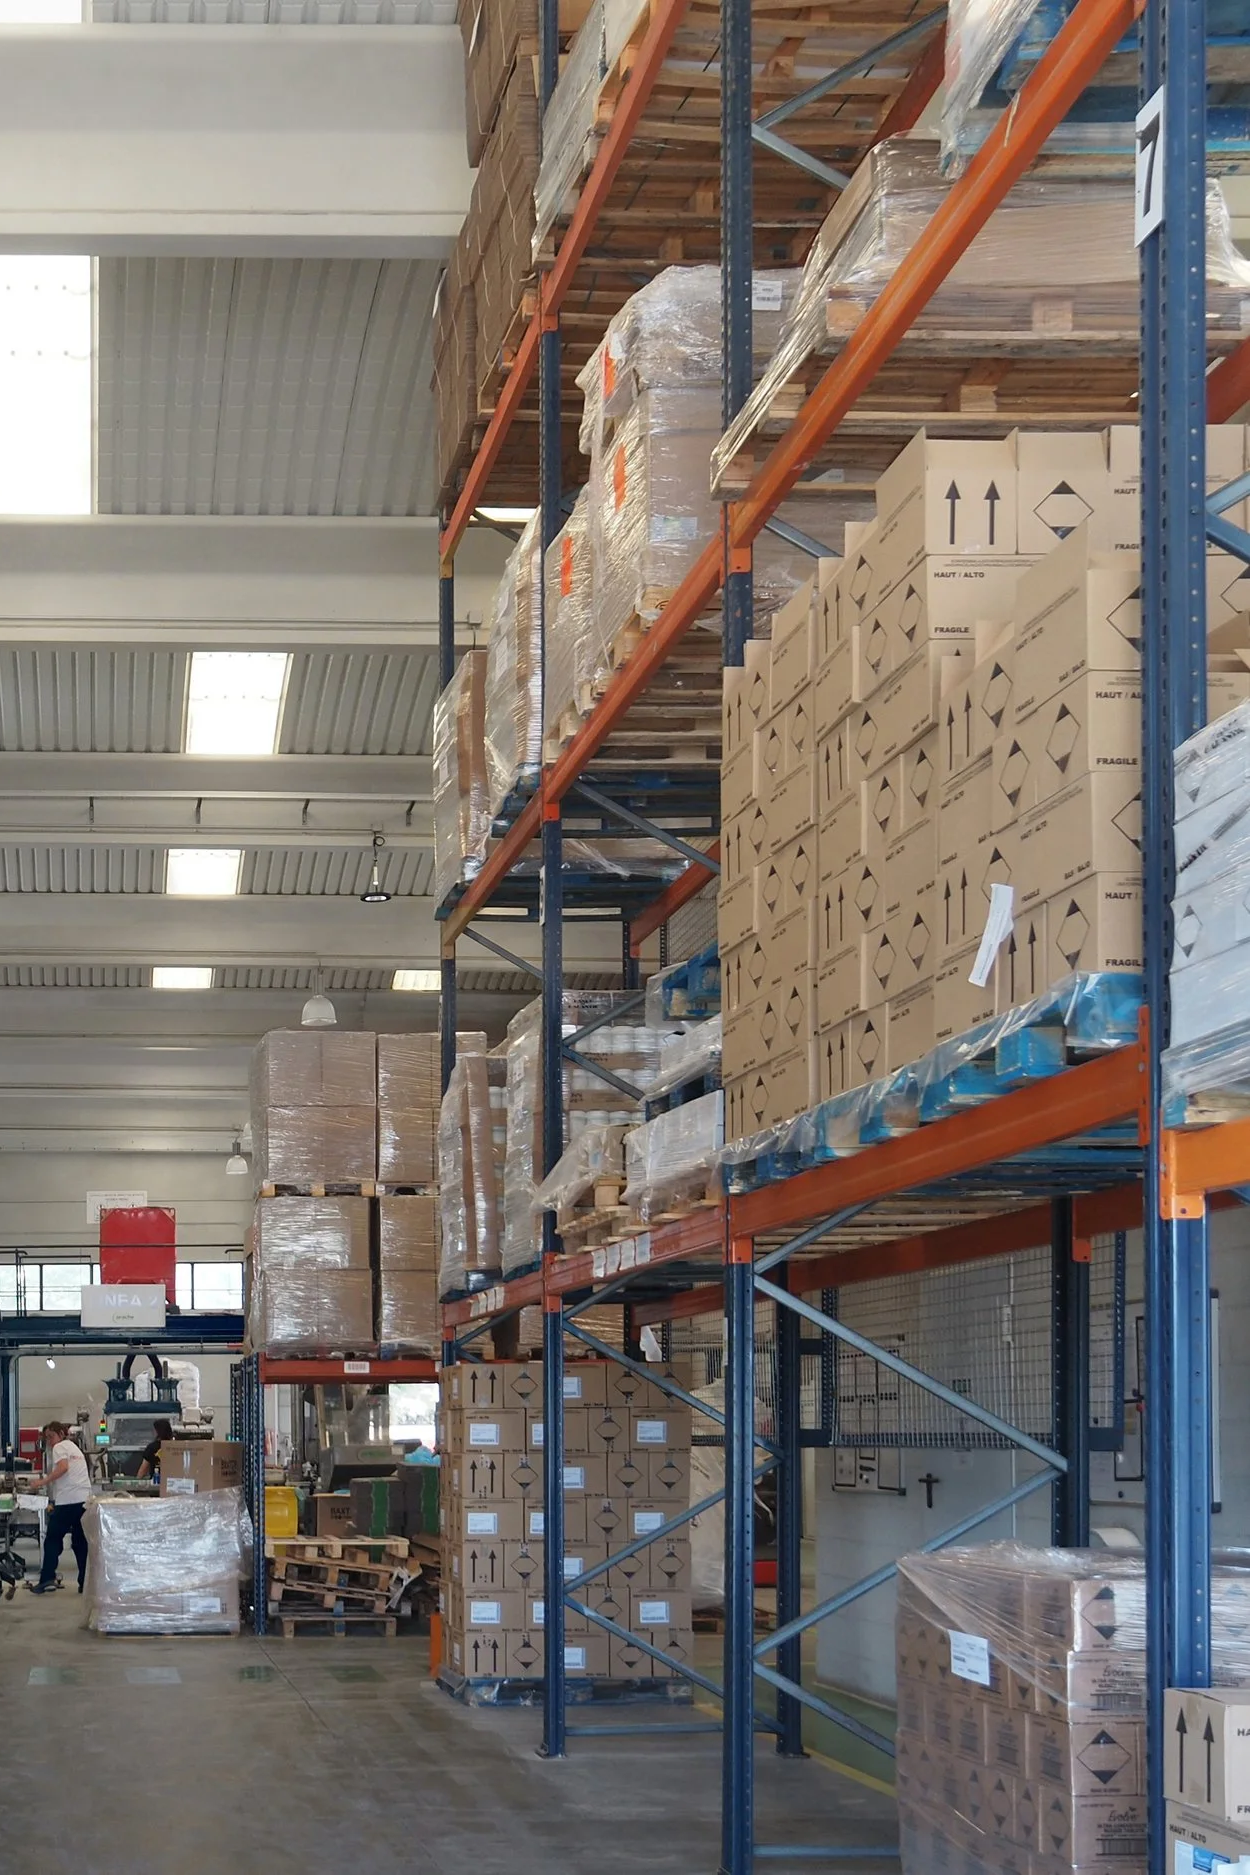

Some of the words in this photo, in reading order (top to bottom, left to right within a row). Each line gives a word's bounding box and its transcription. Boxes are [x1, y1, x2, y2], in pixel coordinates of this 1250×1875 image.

[1140, 112, 1160, 217] 7
[935, 626, 970, 634] FRAGILE
[1096, 757, 1139, 766] FRAGILE
[1105, 892, 1133, 900] HAUT
[1105, 959, 1141, 967] FRAGIL
[1169, 1824, 1186, 1837] HAUT
[1191, 1831, 1207, 1844] ALTO
